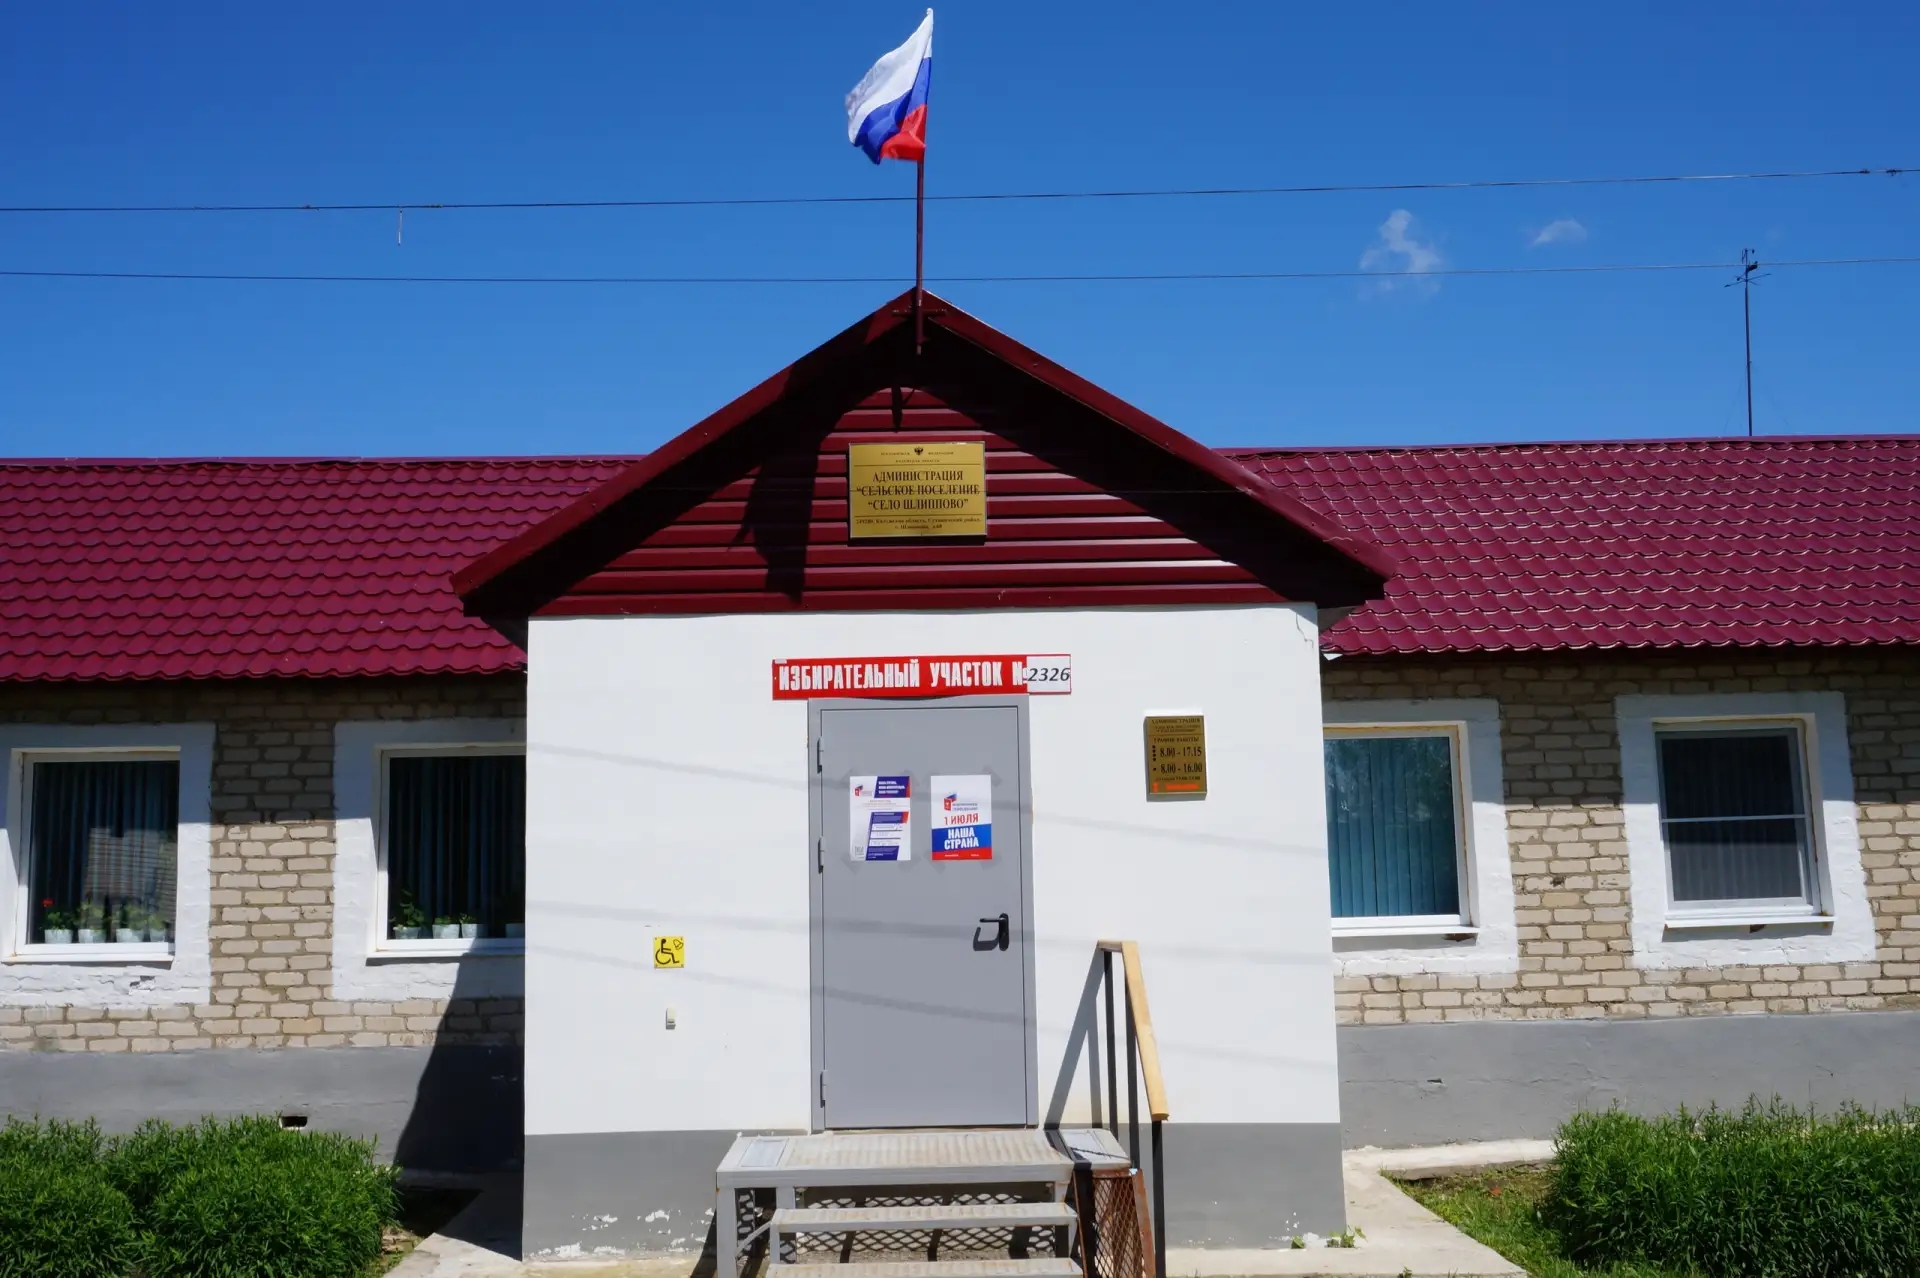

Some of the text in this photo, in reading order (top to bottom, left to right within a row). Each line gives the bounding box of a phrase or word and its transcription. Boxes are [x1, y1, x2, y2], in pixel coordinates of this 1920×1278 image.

[873, 470, 963, 483] АДМИНИСТРАЦИЯ
[917, 484, 981, 496] ПОСЕЛЕНИЕ
[779, 658, 920, 691] ИЗБИРАТЕЛЬНЫЙ
[929, 661, 1003, 689] УЧАСТОК
[1027, 667, 1071, 682] 2326
[1183, 746, 1202, 757] 17.15
[1183, 762, 1203, 773] 16.00
[944, 813, 979, 826] 1 ИЮЛЯ
[948, 827, 975, 839] НАША
[944, 837, 979, 850] СТРАНА
